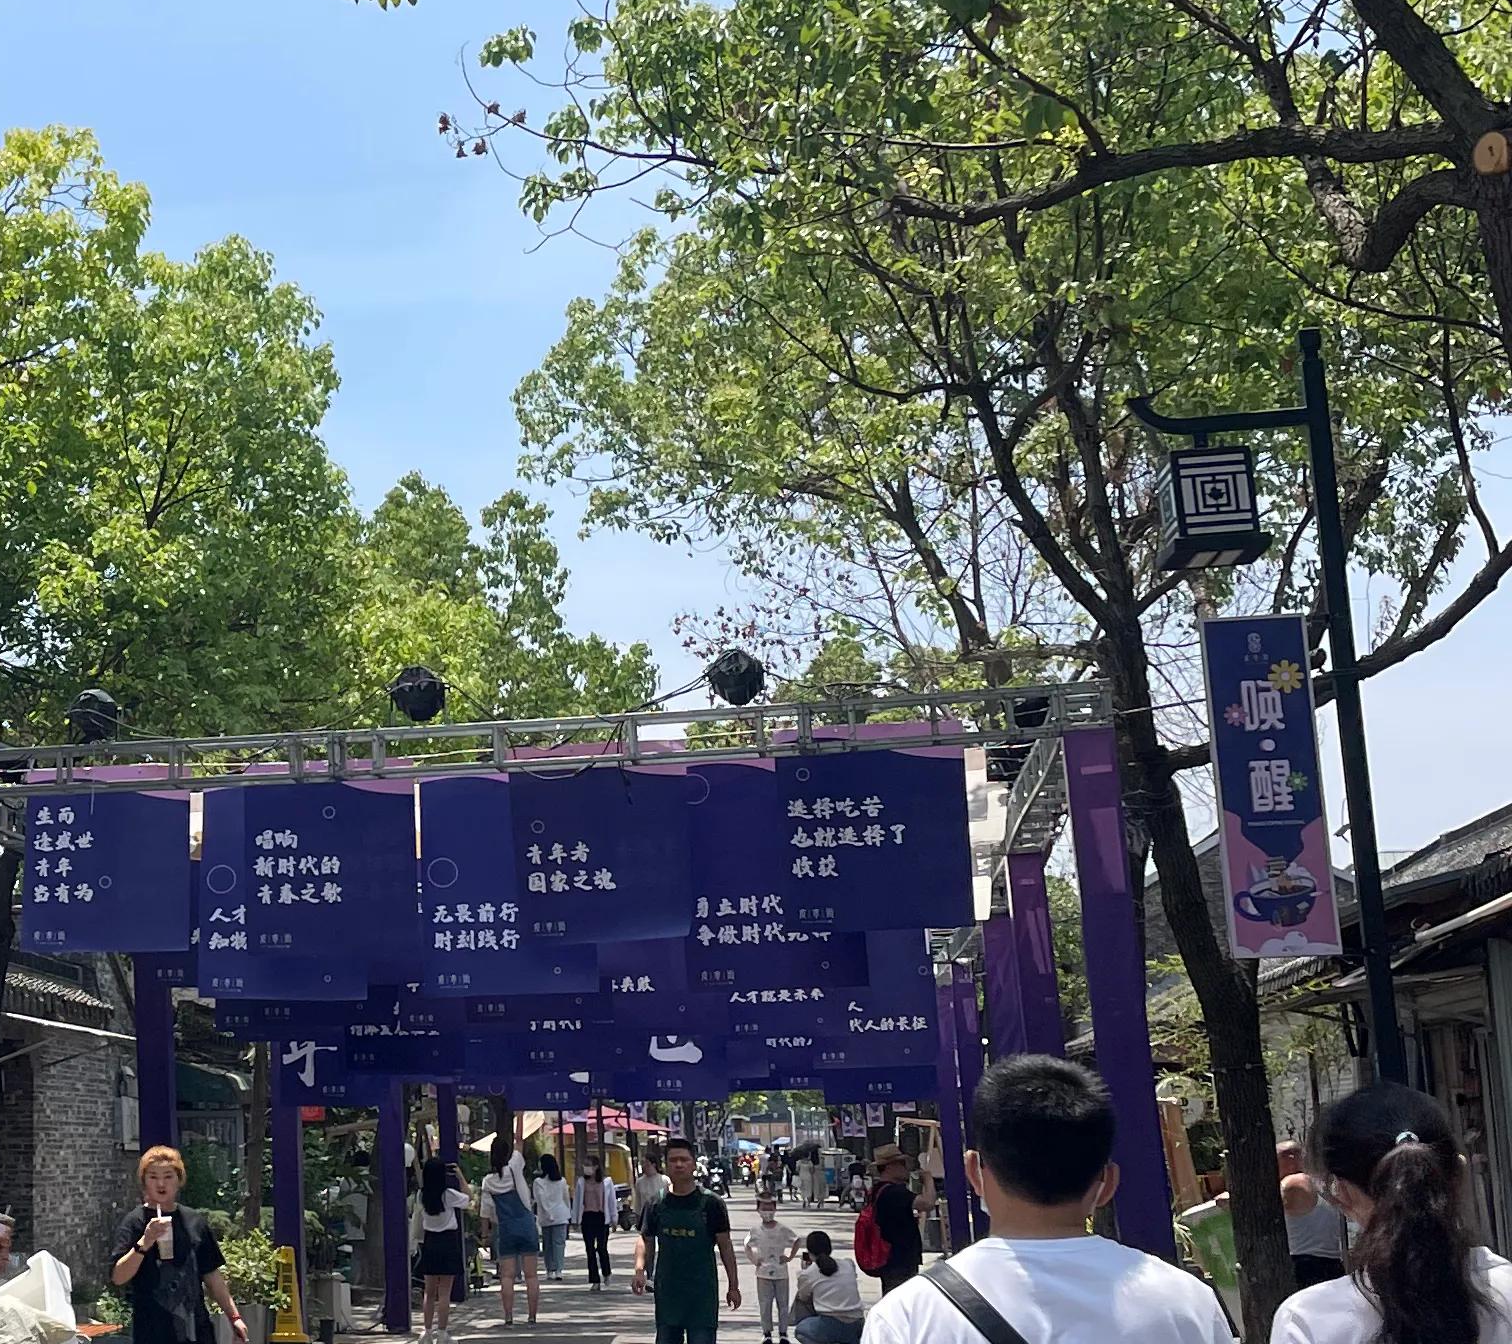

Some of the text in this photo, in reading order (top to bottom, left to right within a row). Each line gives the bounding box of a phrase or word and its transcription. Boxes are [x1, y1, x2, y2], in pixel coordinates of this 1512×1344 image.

[35, 806, 75, 826] 生而
[787, 795, 884, 820] 选择吃苦
[255, 829, 298, 850] 唱响
[790, 824, 906, 848] 也就选择了
[526, 841, 590, 865] 青年者
[34, 857, 73, 878] 青年
[252, 855, 341, 878] 新时代的
[791, 854, 839, 878] 收获
[34, 882, 94, 904] 当有为
[257, 881, 343, 905] 青春之歌
[528, 868, 617, 894] 国家之魂
[432, 902, 519, 923] 无畏前行
[695, 894, 784, 918] 勇立时代
[434, 928, 521, 952] 时刻践行
